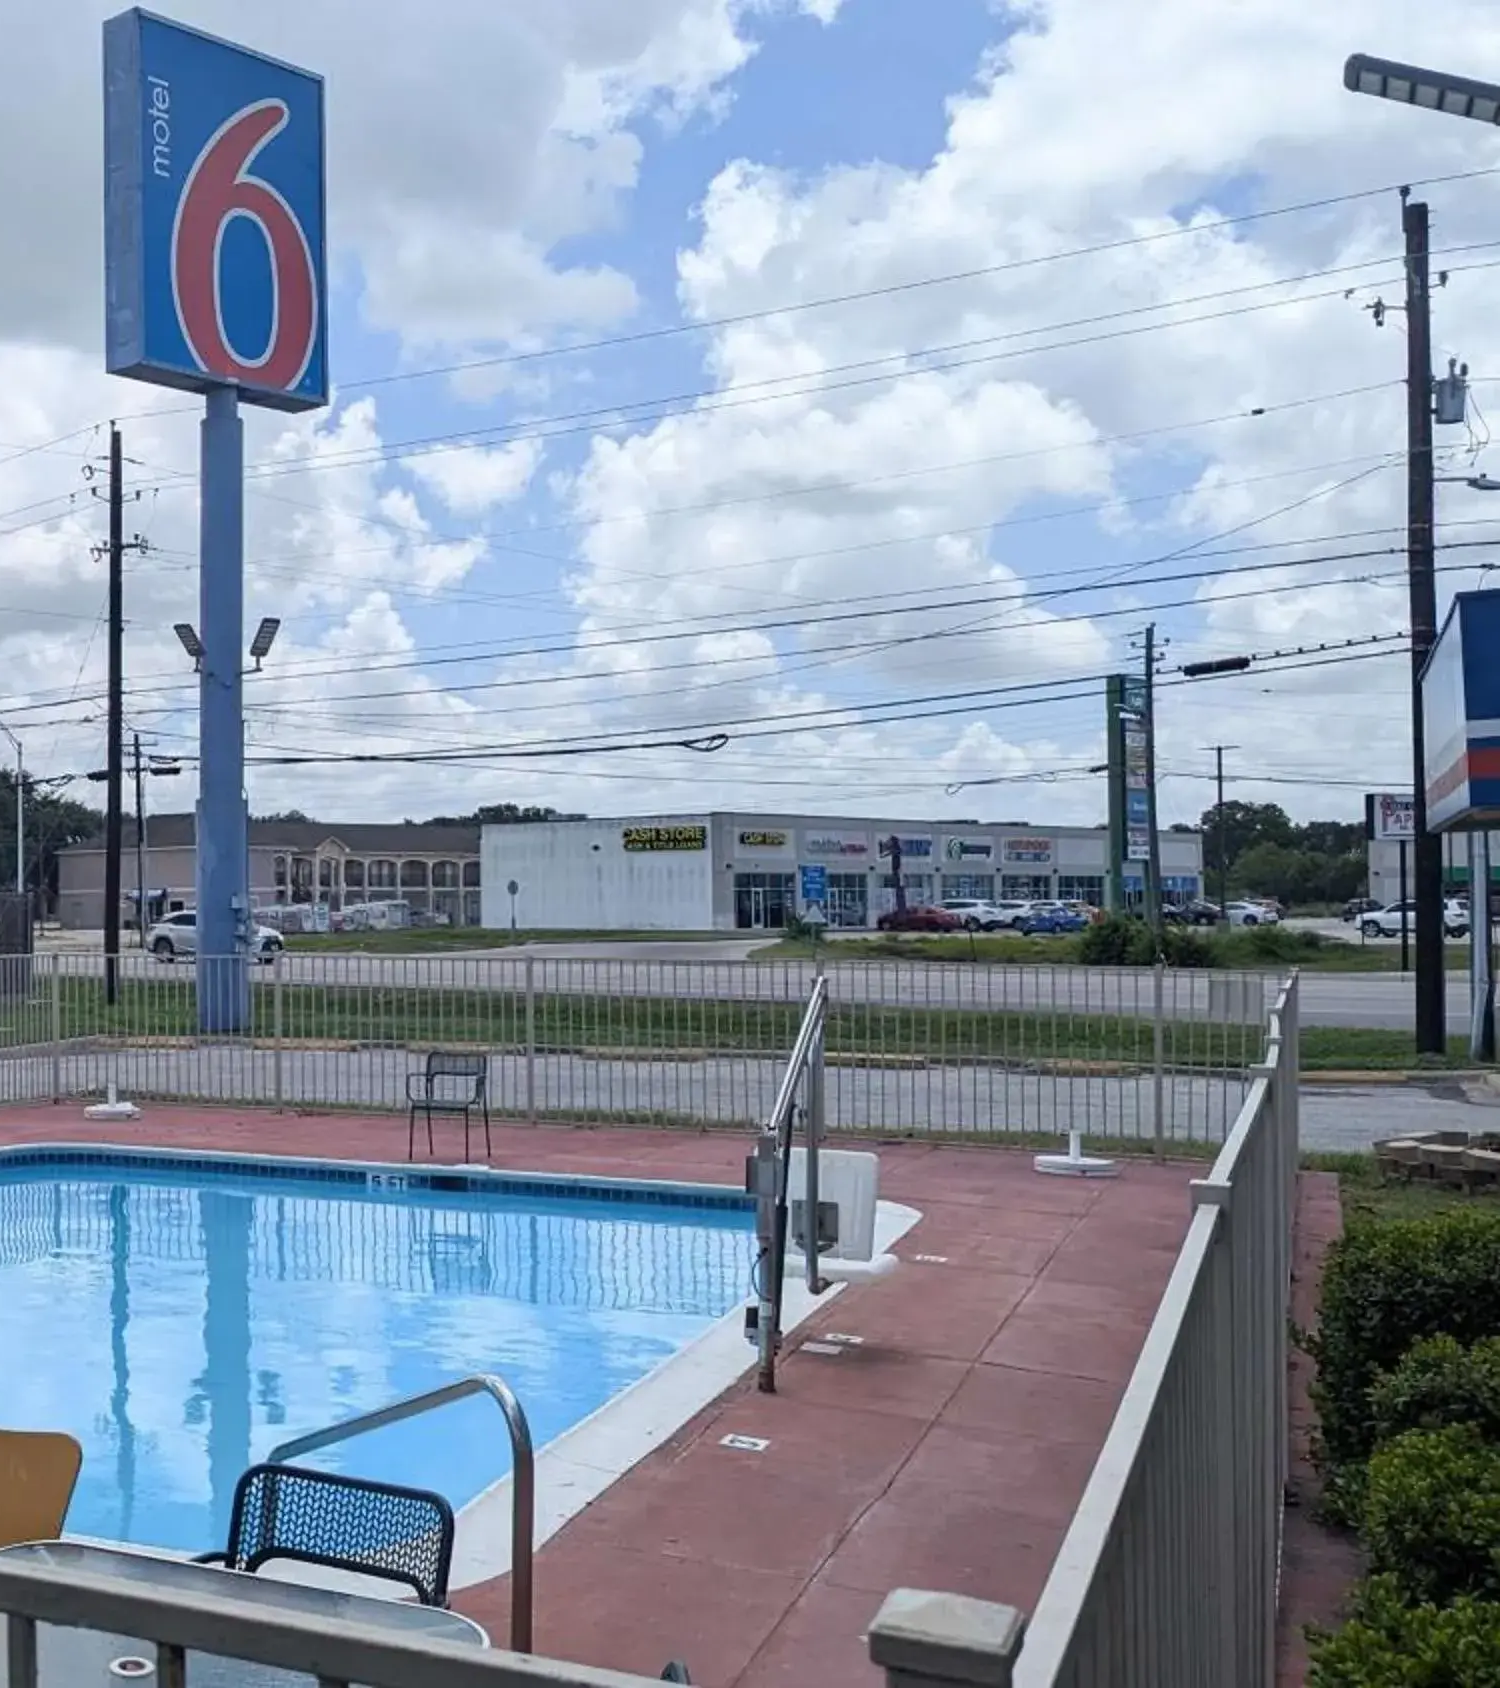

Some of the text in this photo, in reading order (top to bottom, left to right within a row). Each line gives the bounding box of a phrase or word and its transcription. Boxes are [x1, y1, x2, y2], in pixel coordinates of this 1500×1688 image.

[147, 76, 171, 178] motel
[170, 96, 318, 391] 6
[659, 827, 704, 841] STORE
